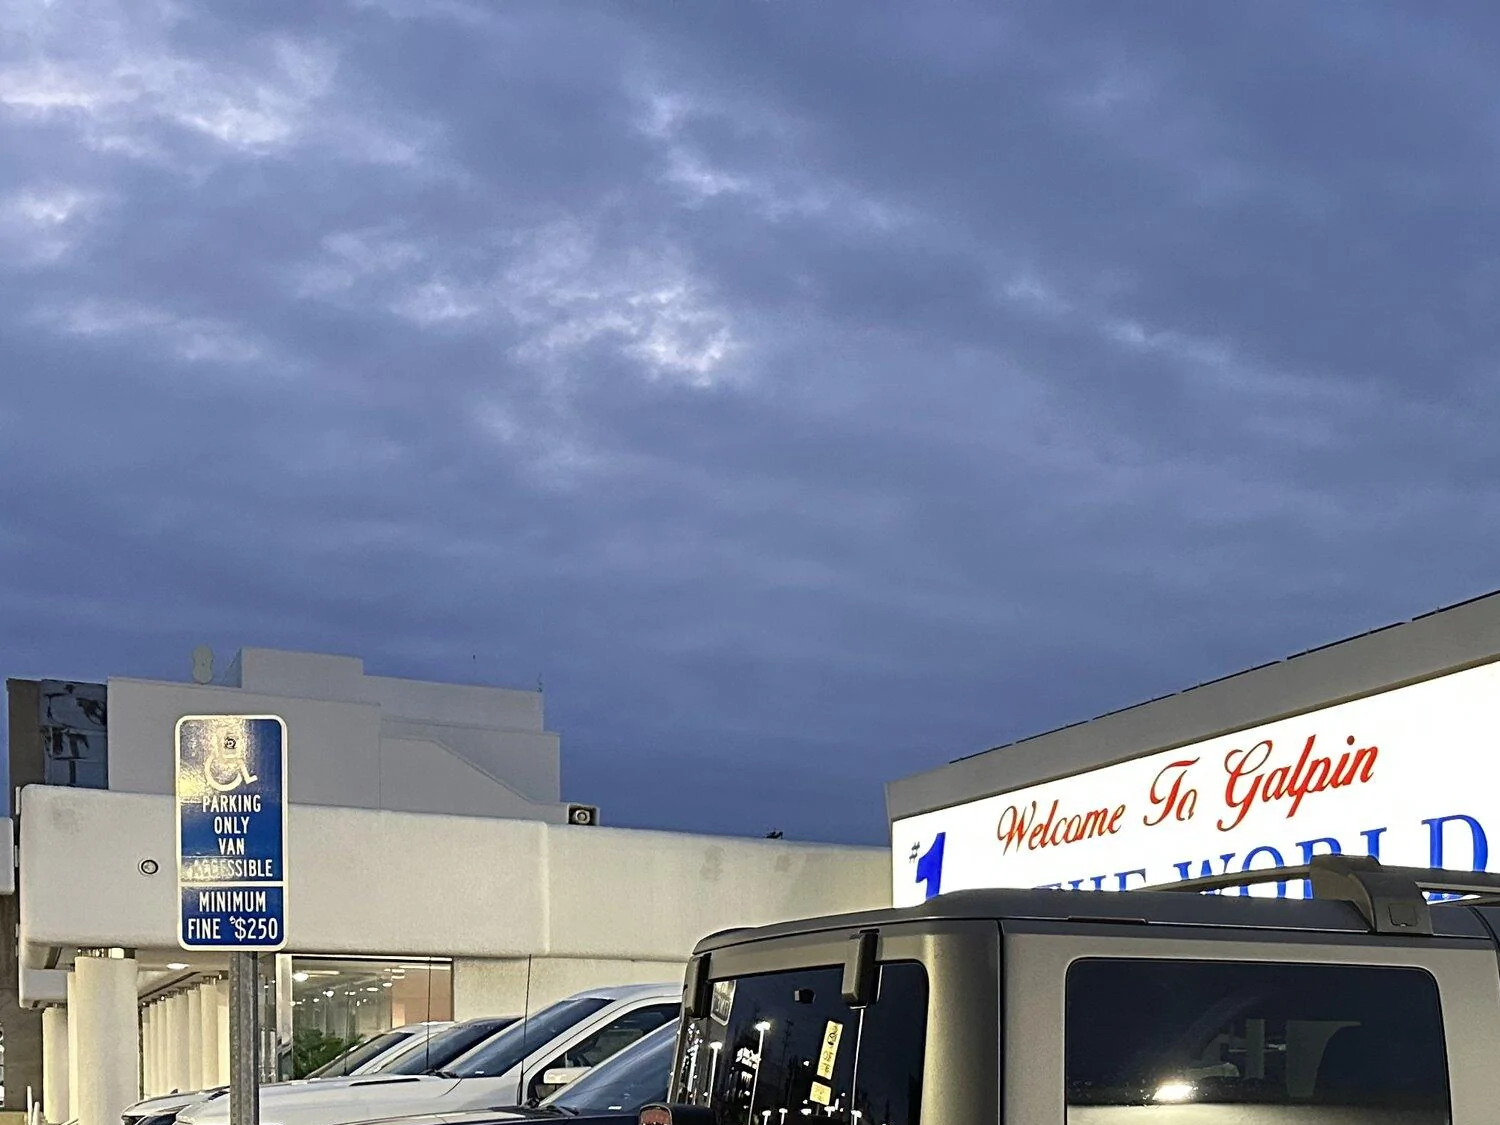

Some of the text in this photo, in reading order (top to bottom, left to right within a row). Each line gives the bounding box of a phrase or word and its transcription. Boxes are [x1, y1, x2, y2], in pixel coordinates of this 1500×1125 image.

[202, 794, 261, 813] PARKING
[997, 733, 1379, 856] Welcome To Galpin
[213, 816, 250, 834] ONLY
[218, 838, 245, 855] VAN
[192, 859, 273, 877] ACCESSIBLE
[199, 891, 266, 913] MINIMUM
[187, 917, 278, 941] FINE $250
